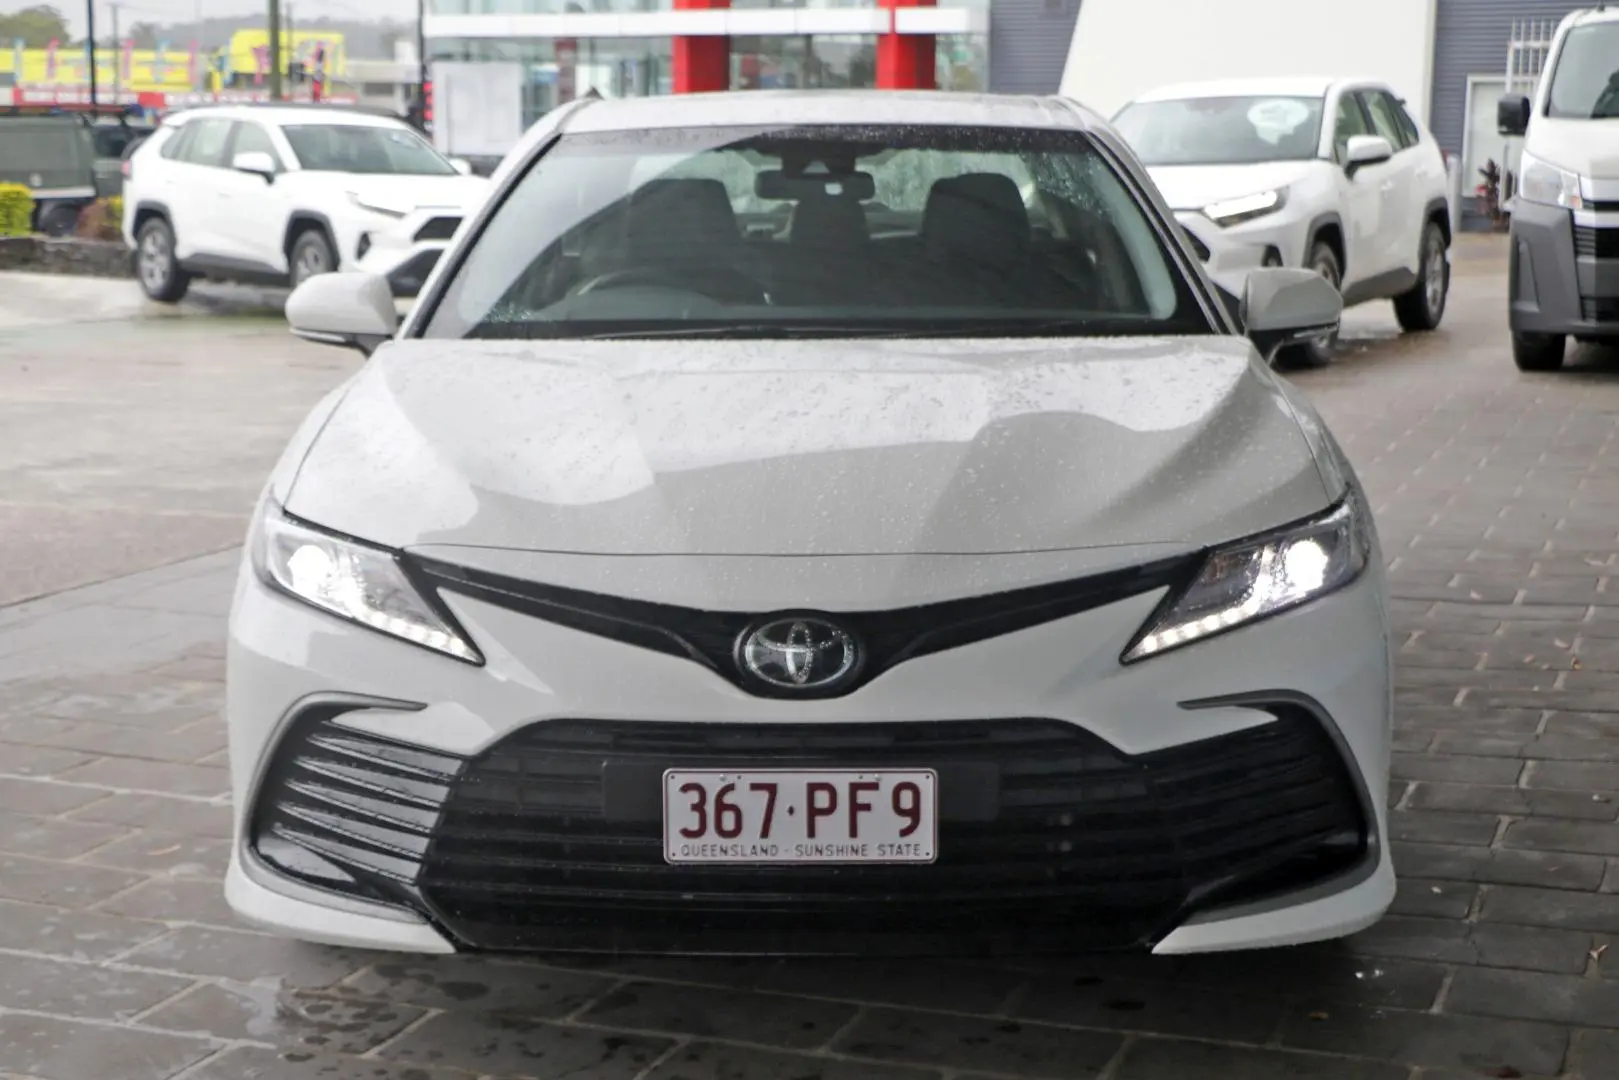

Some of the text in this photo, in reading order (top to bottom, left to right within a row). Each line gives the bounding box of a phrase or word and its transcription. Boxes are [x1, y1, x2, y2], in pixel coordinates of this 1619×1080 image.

[680, 843, 779, 857] QUEENSLAND
[794, 843, 868, 857] SUNSHINE
[876, 843, 921, 857] STATE
